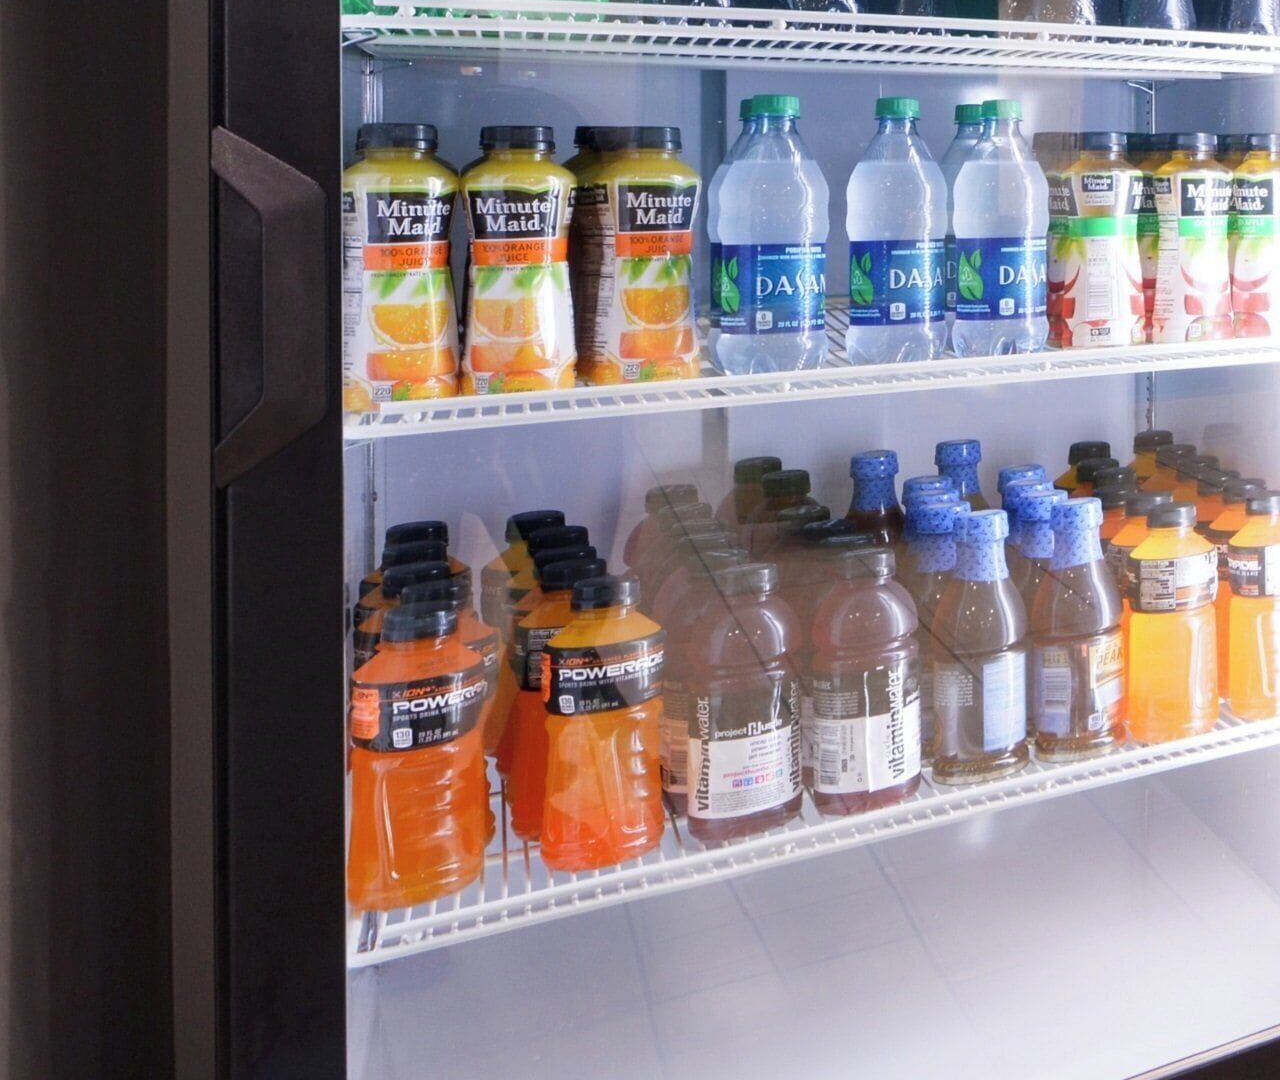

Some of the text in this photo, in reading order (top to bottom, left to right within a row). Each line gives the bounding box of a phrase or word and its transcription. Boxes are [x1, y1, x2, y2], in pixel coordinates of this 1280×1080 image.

[376, 198, 450, 218] Minute
[475, 197, 552, 215] Minute
[625, 192, 692, 209] Minute
[486, 214, 542, 232] Maid
[635, 208, 683, 225] Maid
[386, 218, 442, 236] Maid
[503, 242, 546, 253] ORANGE
[646, 244, 670, 254] JUIC
[400, 257, 431, 267] JUIC
[374, 386, 391, 397] 220
[558, 650, 665, 682] POWERADE
[714, 726, 747, 740] project
